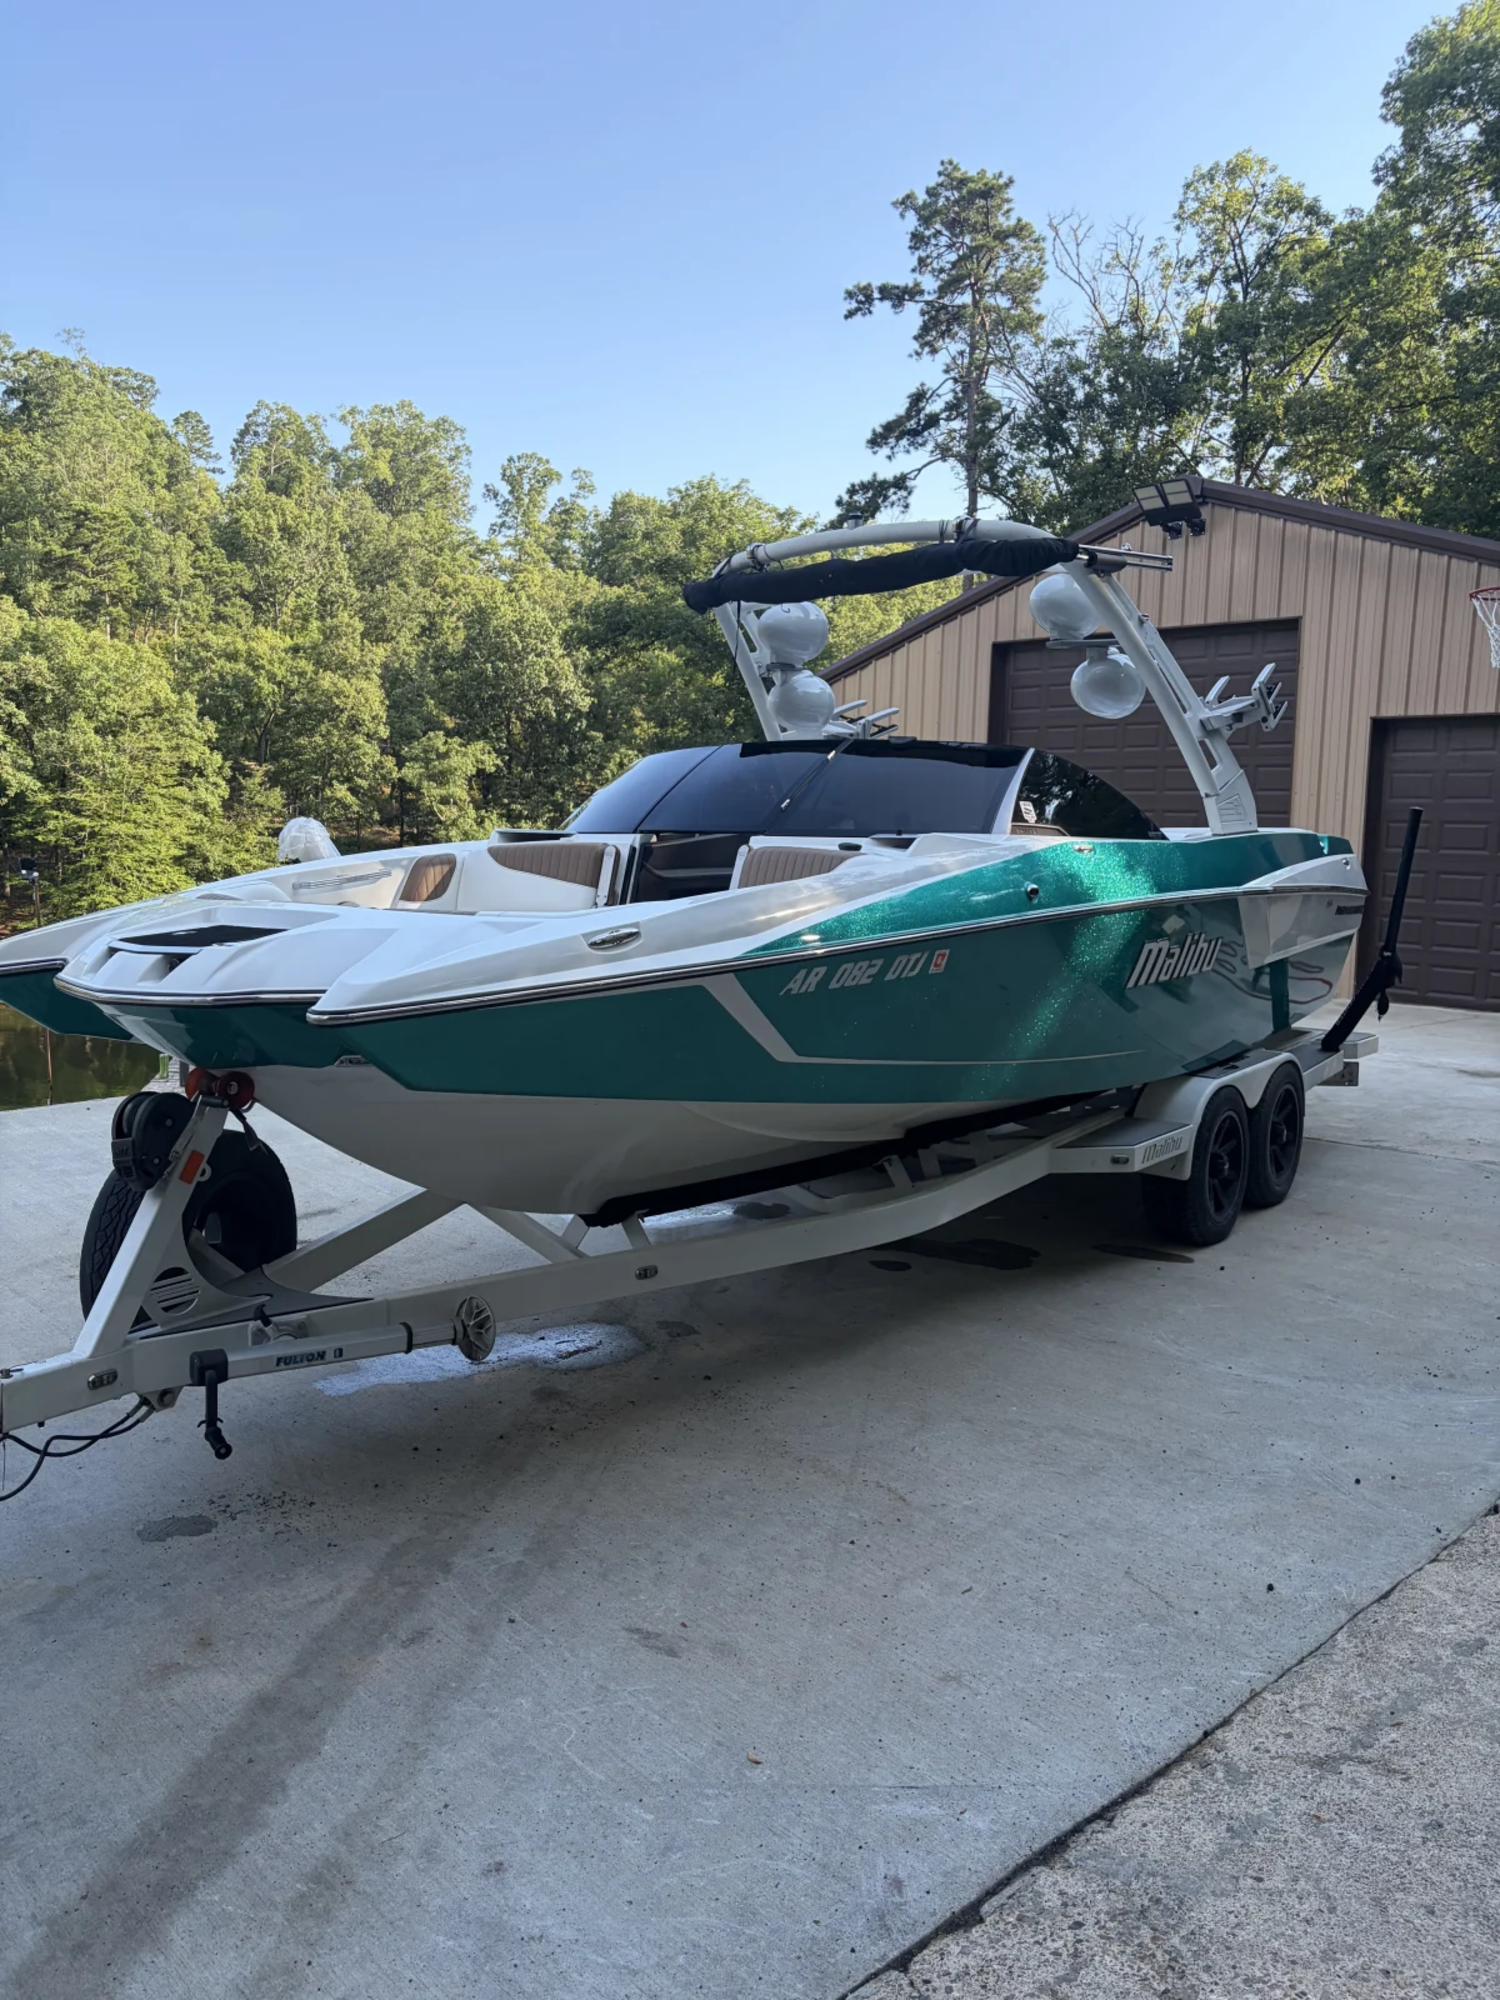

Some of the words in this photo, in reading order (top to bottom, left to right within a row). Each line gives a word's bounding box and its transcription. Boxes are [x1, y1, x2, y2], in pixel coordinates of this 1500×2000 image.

[779, 966, 827, 995] AR
[828, 958, 884, 989] 082
[1125, 932, 1223, 989] Malibu
[1141, 1136, 1183, 1164] Malibu
[275, 1350, 327, 1367] FULTON
